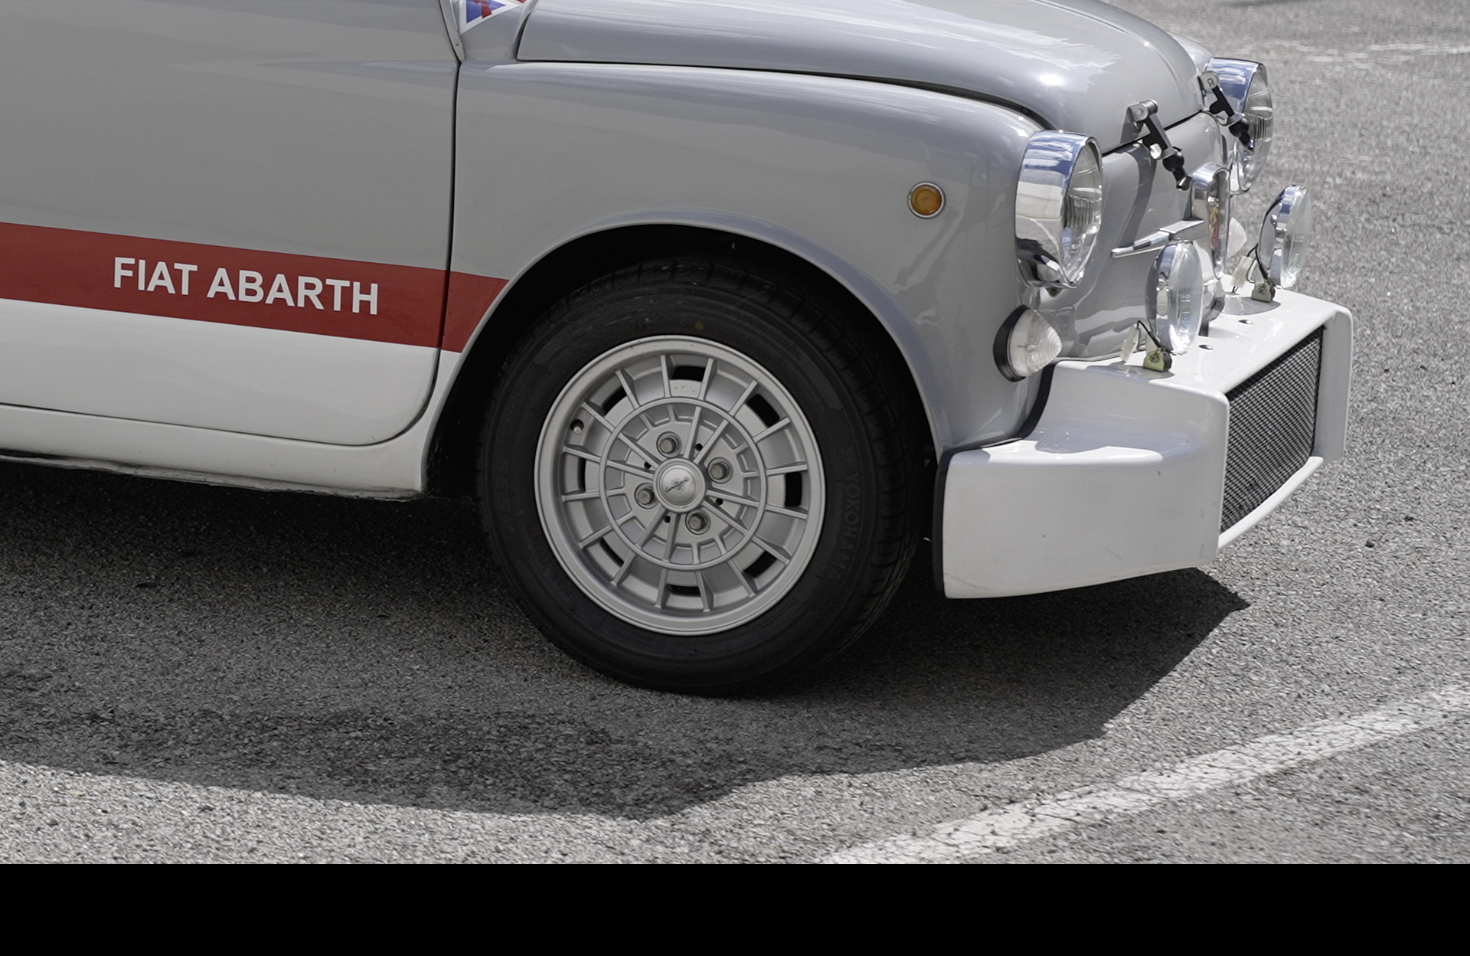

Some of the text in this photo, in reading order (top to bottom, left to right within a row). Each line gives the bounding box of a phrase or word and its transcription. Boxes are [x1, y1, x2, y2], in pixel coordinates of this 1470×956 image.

[113, 256, 379, 315] FIAT ABARTH
[826, 471, 862, 580] YOKOHAMA
